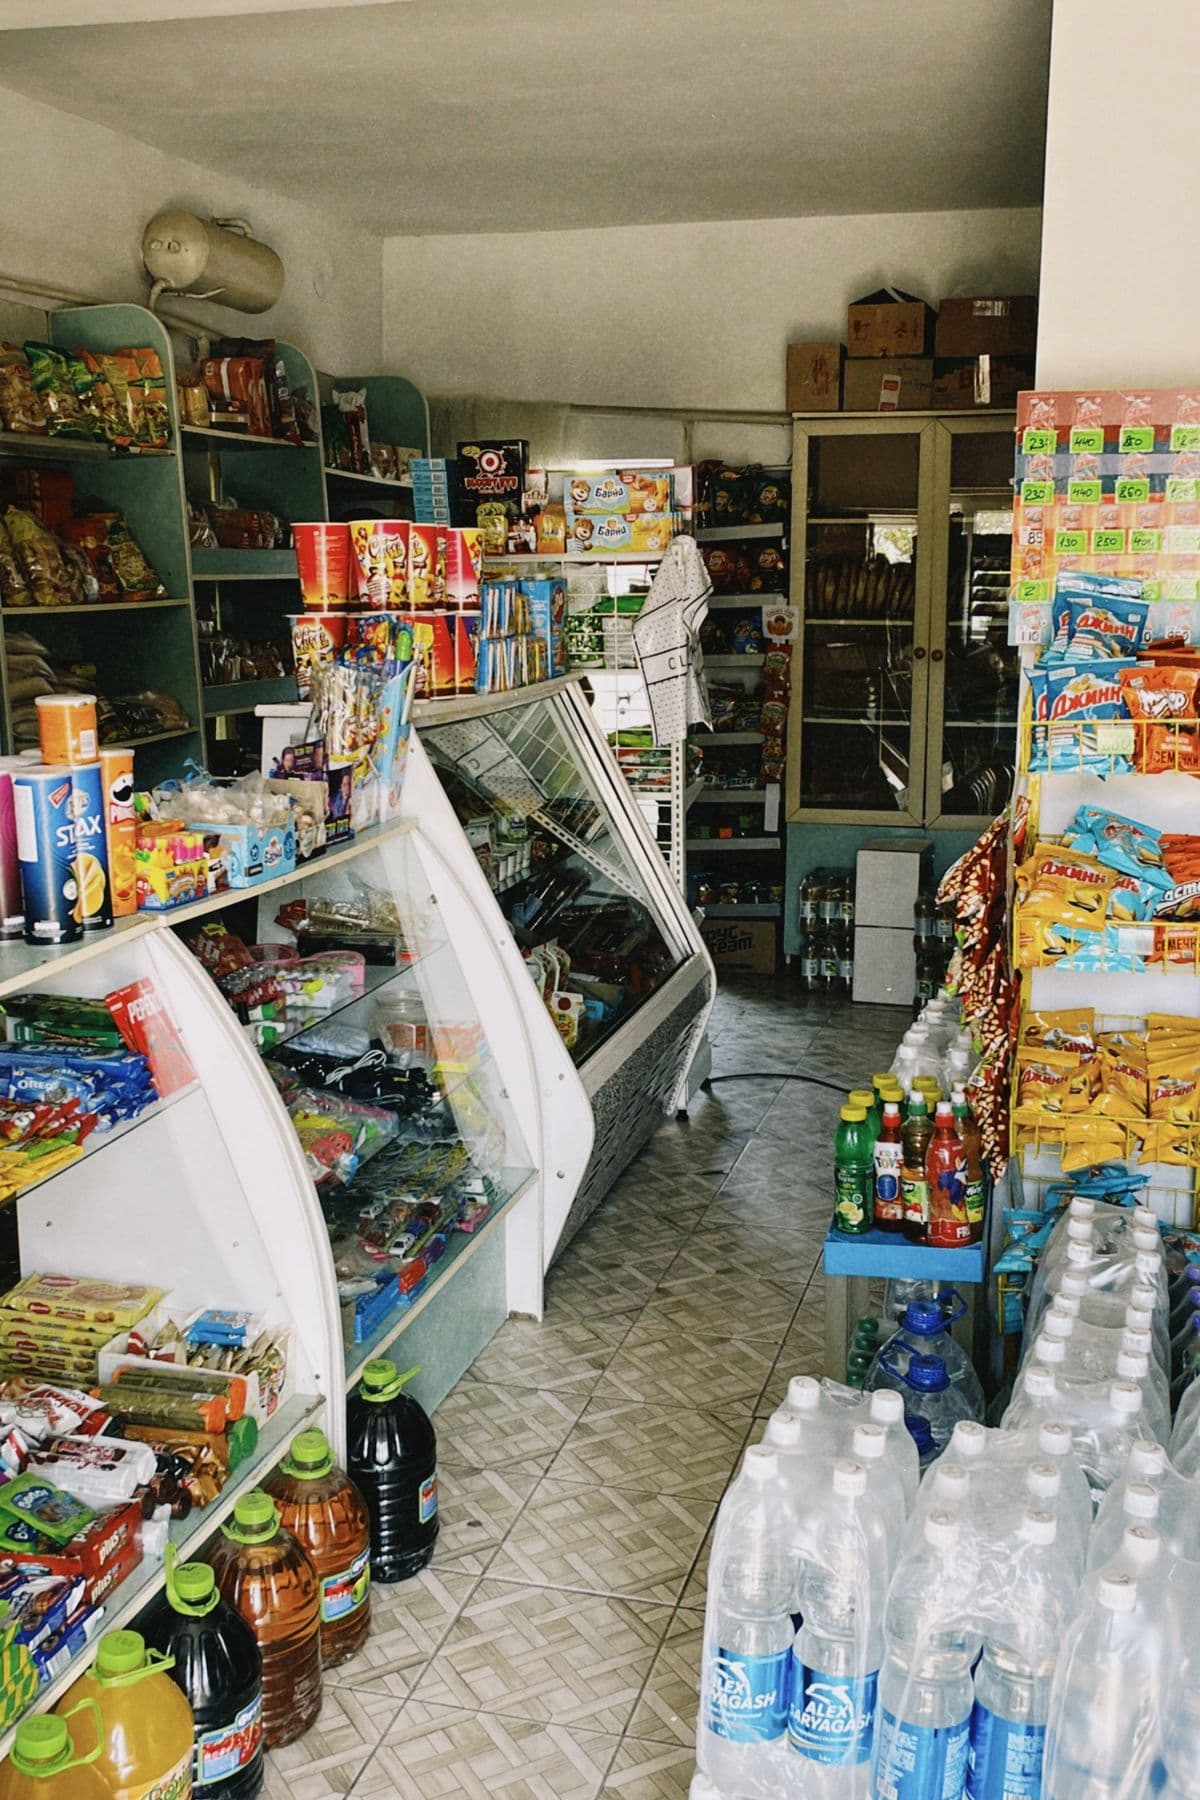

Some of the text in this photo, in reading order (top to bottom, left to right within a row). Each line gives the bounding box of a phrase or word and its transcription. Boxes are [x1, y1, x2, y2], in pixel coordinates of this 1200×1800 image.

[1074, 435, 1096, 447] 440
[595, 487, 624, 498] Барни
[1024, 488, 1046, 501] 230
[597, 525, 627, 537] Барни
[1027, 531, 1043, 545] 85
[1096, 535, 1118, 547] 250
[56, 814, 102, 847] STAX
[712, 1676, 745, 1696] LEX
[805, 1700, 850, 1719] ALEX
